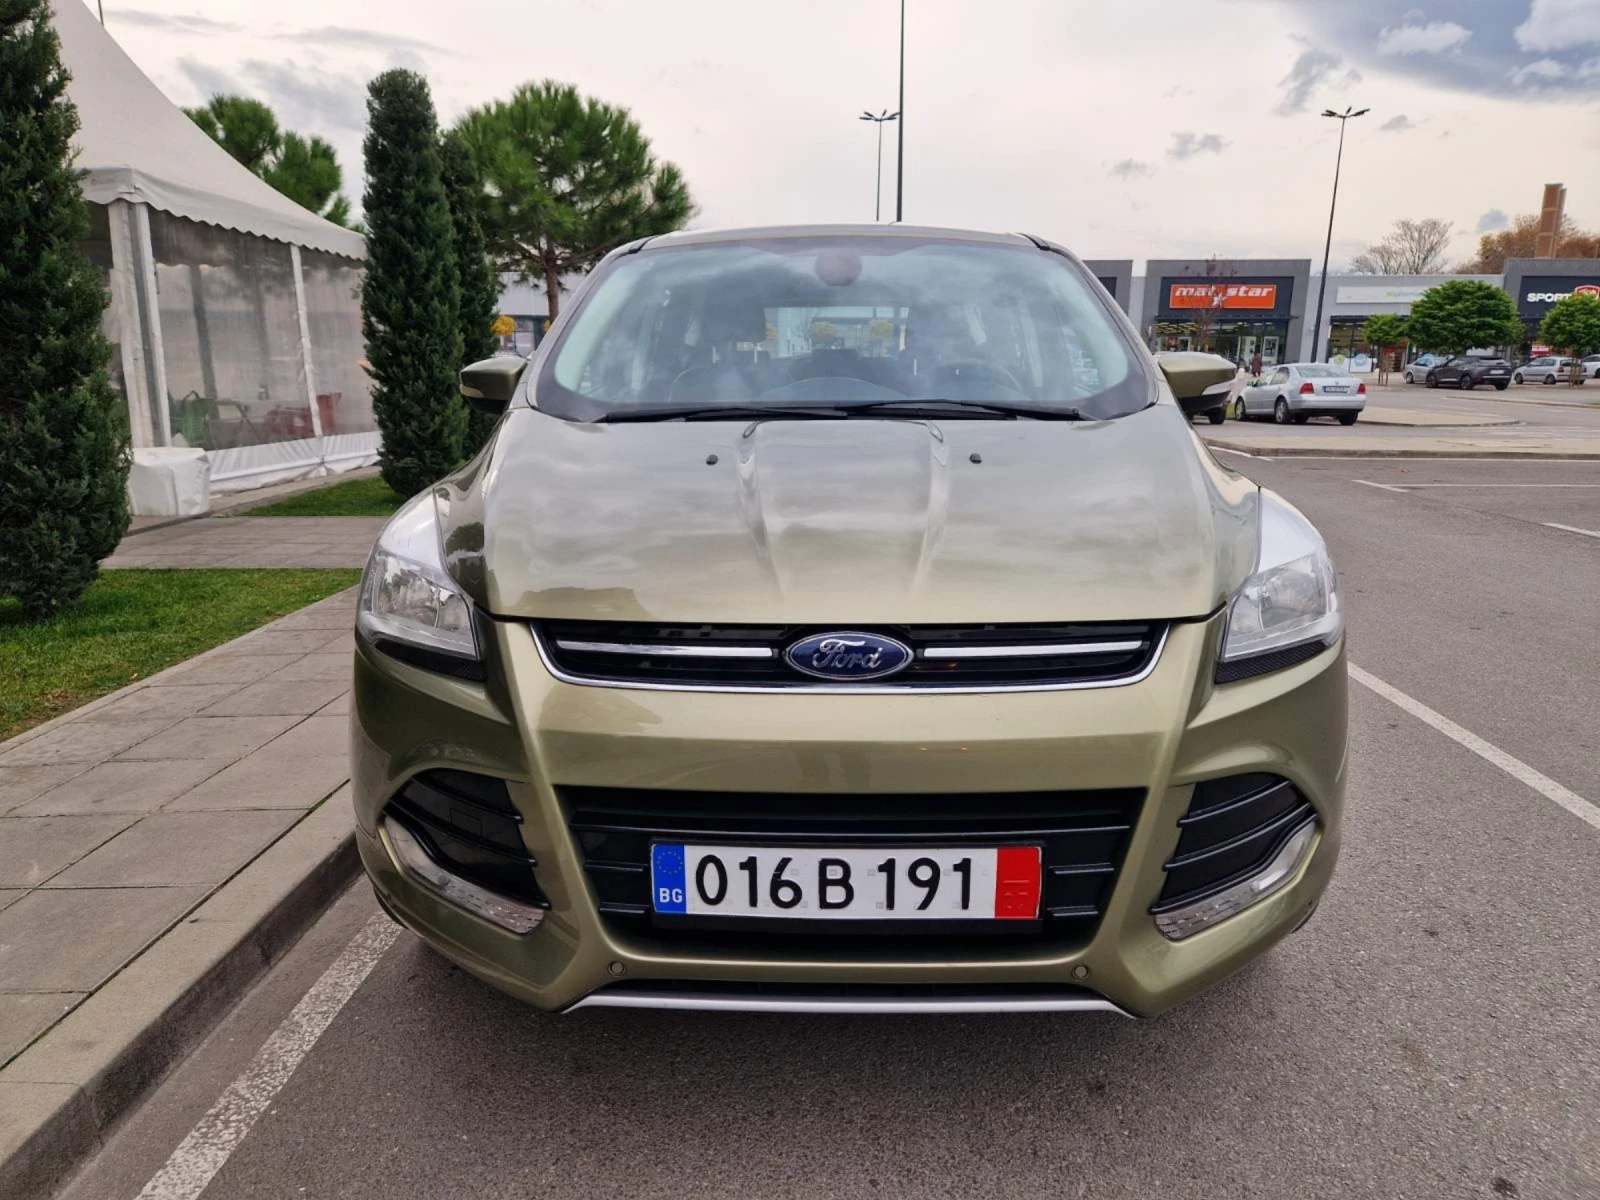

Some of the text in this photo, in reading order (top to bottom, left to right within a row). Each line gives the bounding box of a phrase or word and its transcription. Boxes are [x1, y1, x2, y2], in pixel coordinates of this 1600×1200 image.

[1527, 293, 1572, 302] SPORT
[812, 639, 883, 668] Ford
[659, 887, 683, 903] BG
